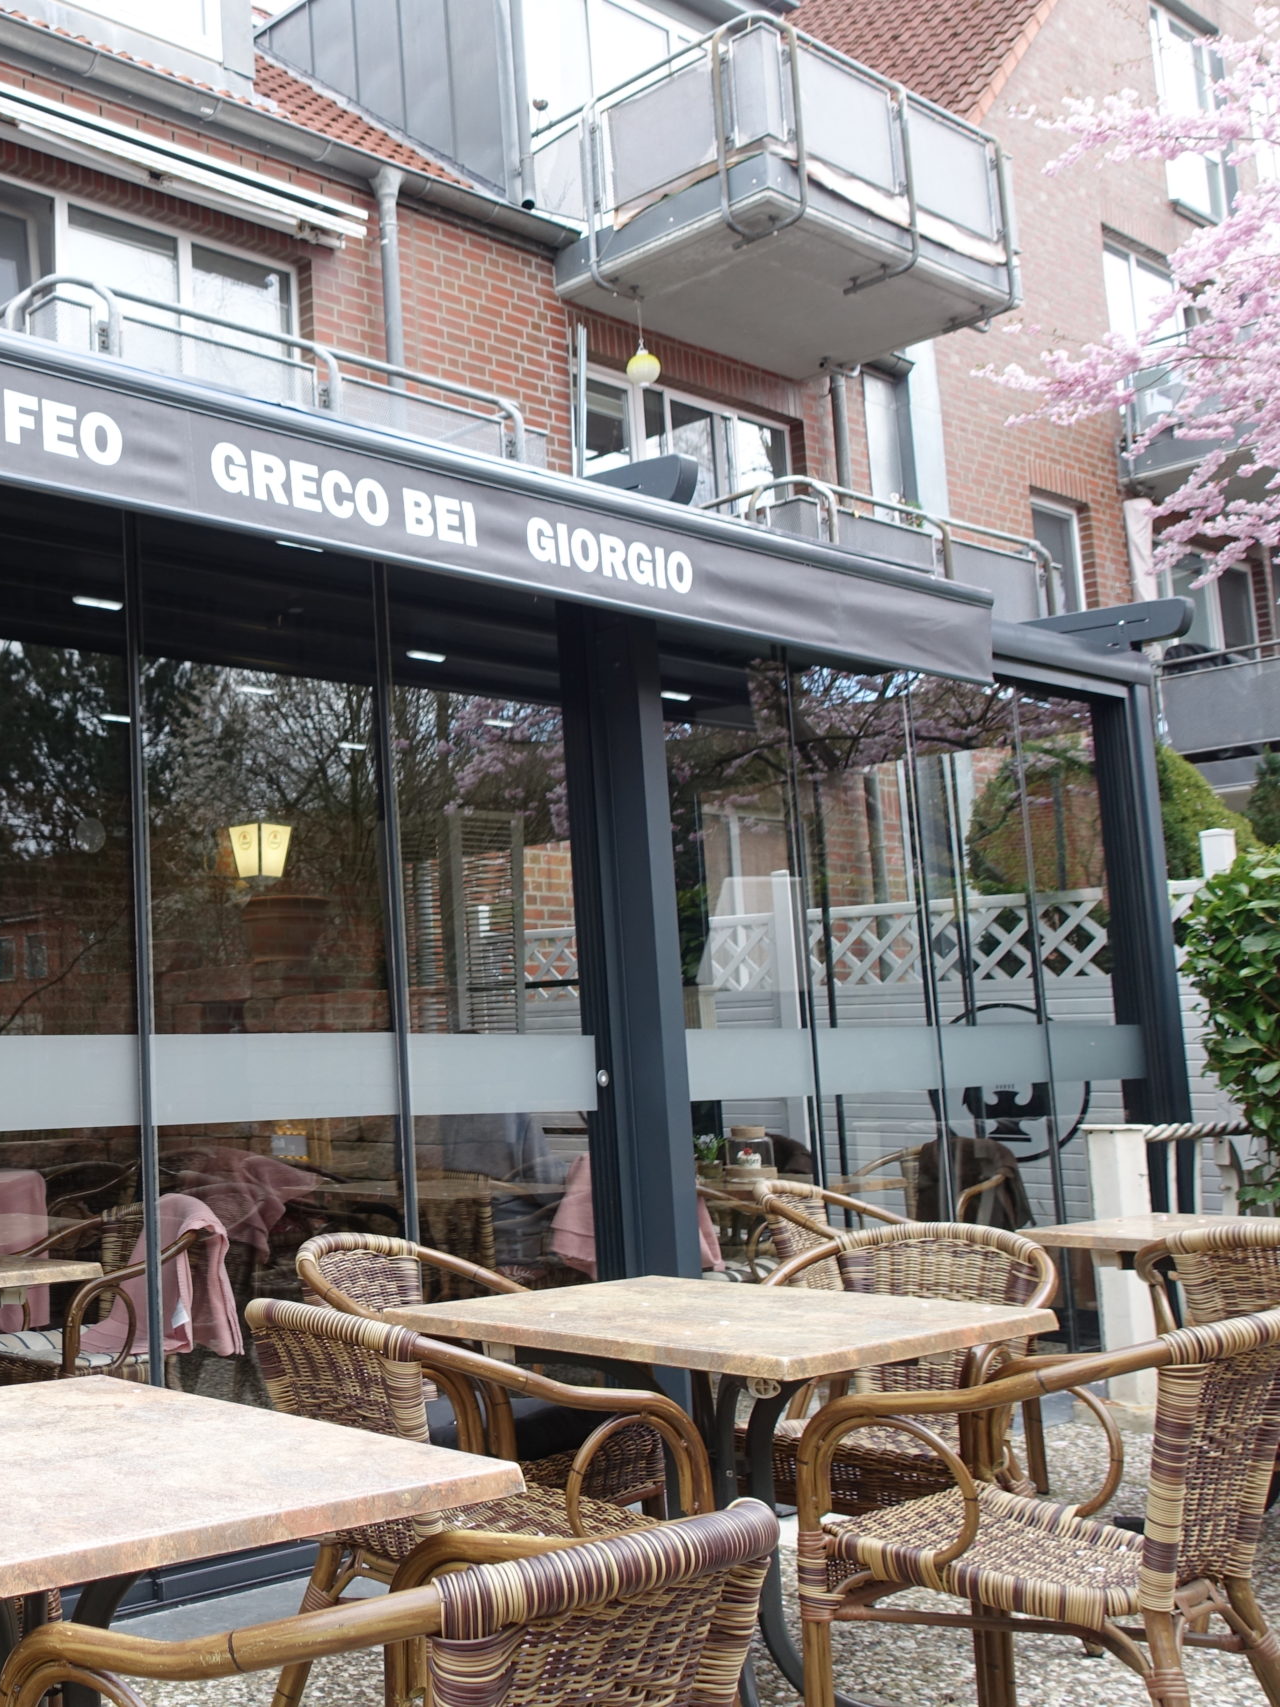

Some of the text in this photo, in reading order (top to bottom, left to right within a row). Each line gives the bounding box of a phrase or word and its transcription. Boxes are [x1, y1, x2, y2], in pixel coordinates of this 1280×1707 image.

[211, 442, 389, 526] GRECO
[403, 488, 478, 548] BEI
[527, 517, 693, 595] GIORGIO
